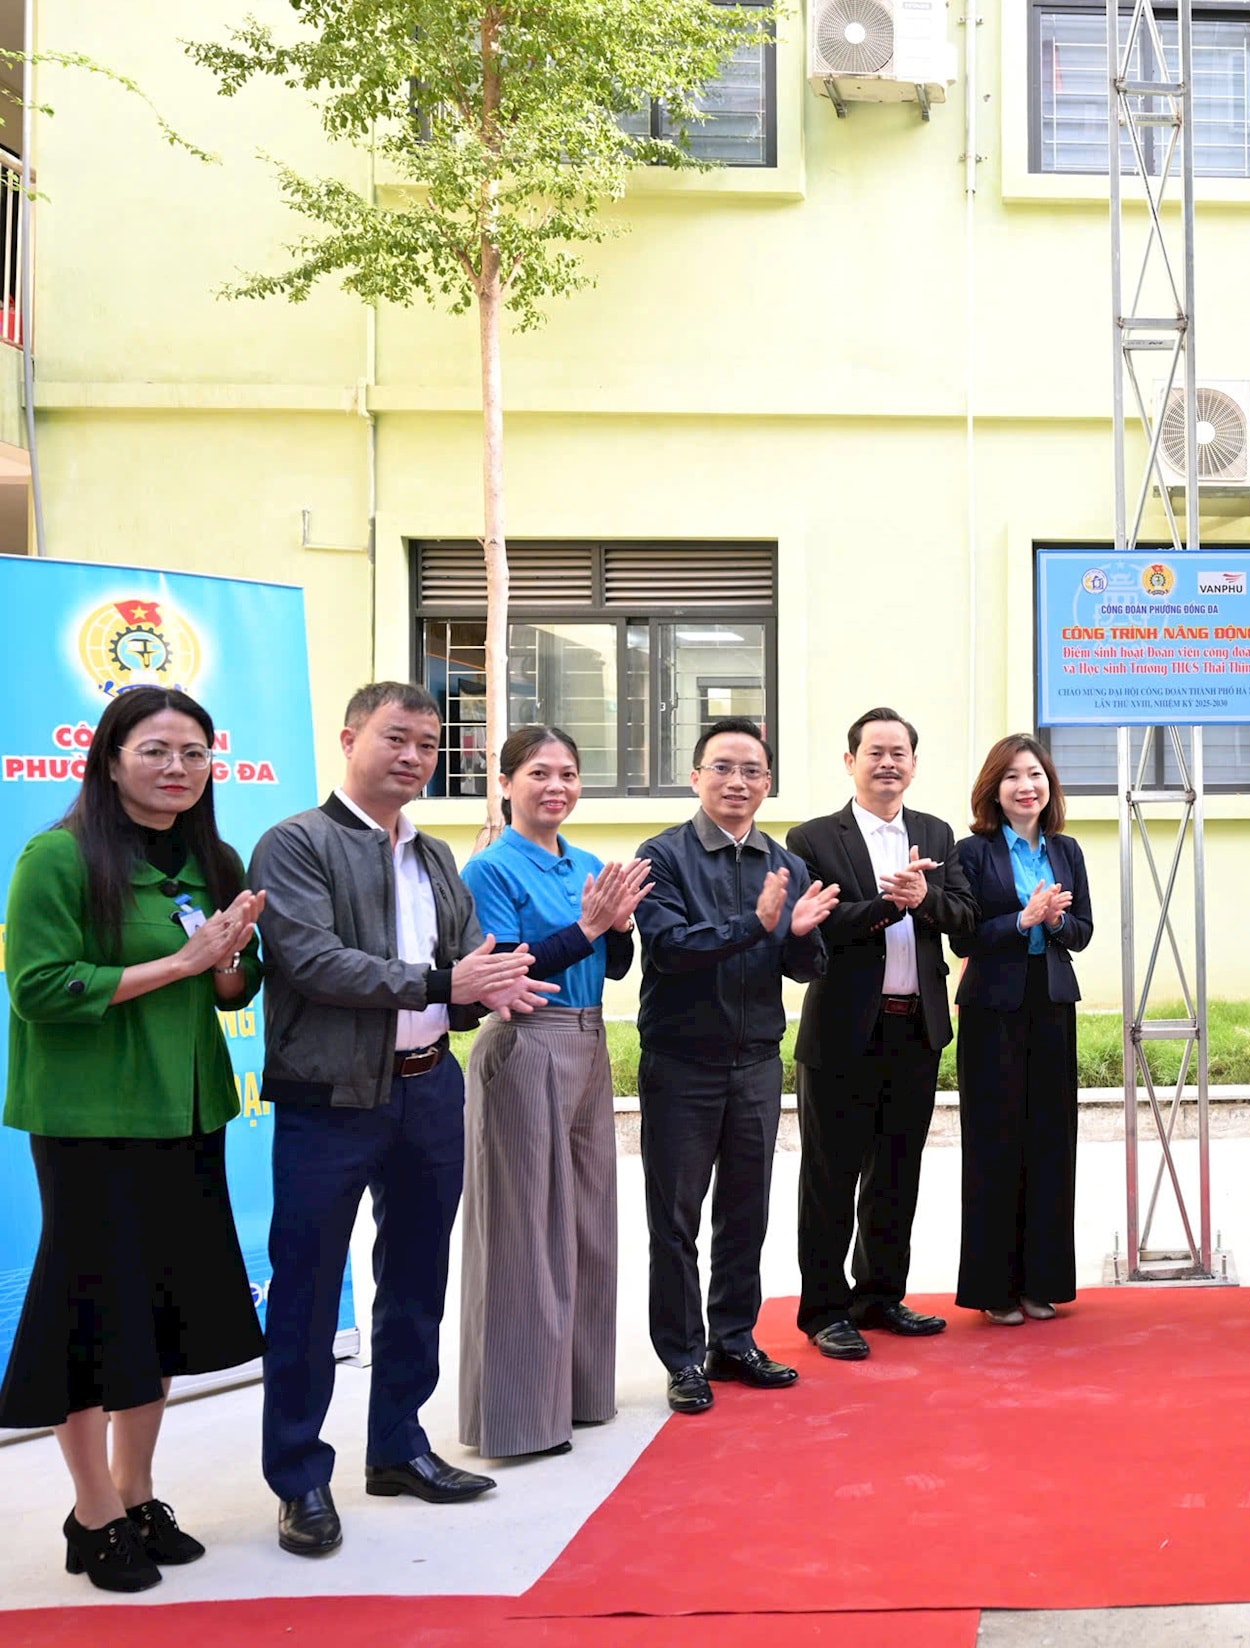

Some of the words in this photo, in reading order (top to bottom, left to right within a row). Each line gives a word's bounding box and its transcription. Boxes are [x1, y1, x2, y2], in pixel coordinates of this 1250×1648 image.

[1199, 584, 1243, 594] VANPHU
[1062, 625, 1105, 640] CÔNG
[1110, 624, 1158, 640] TRÌNH
[1163, 625, 1209, 639] NĂNG
[1094, 646, 1117, 658] sinh
[1120, 646, 1144, 659] hoạt
[1079, 662, 1100, 676] Học
[1103, 662, 1126, 674] sinh
[1172, 661, 1199, 673] THCS
[55, 723, 96, 748] CÔ
[5, 753, 88, 779] PHƯỜ
[236, 762, 275, 781] ĐA
